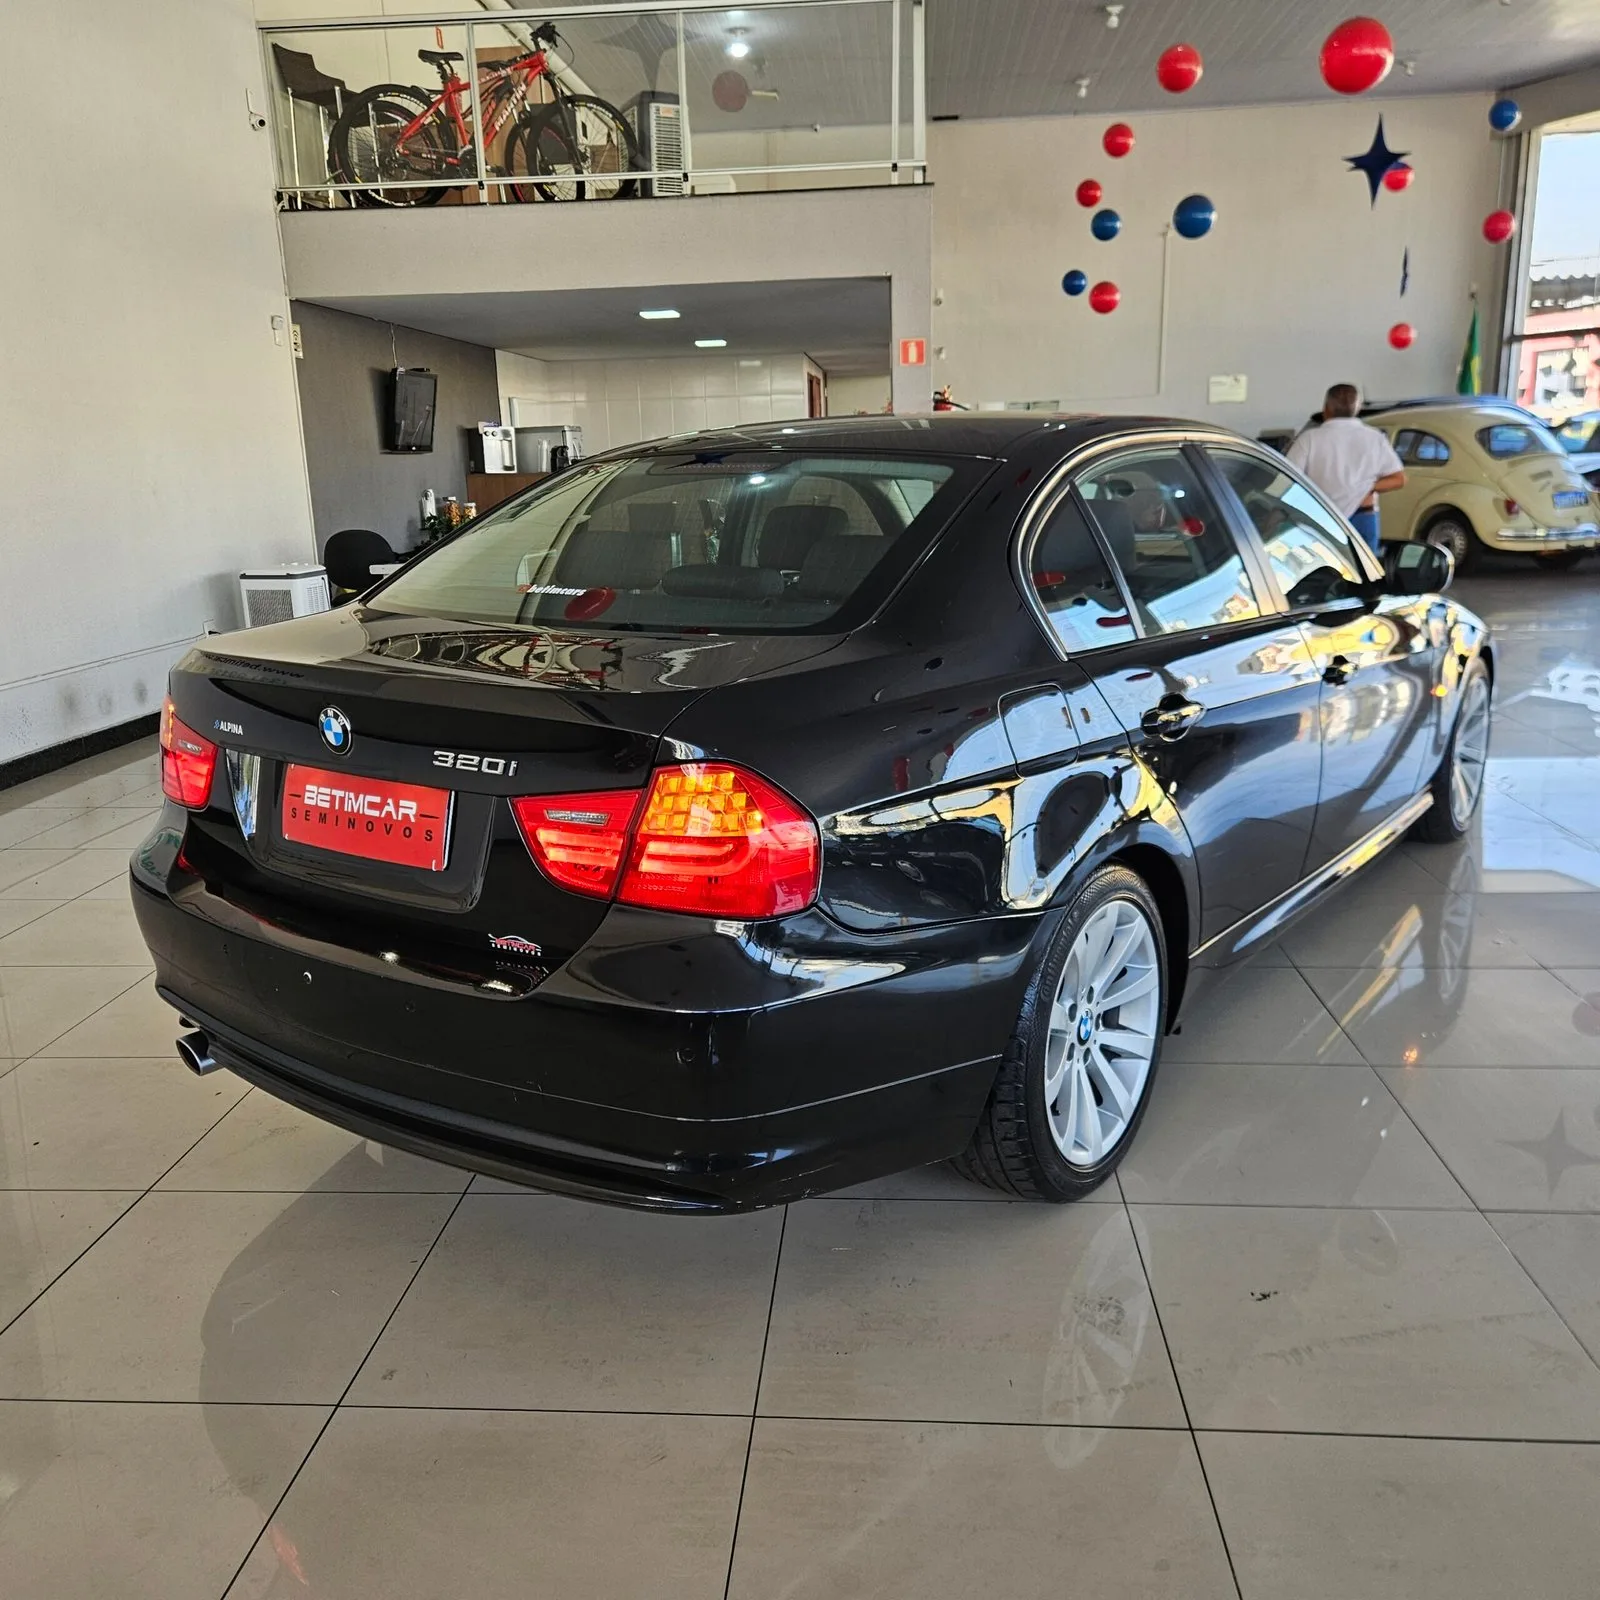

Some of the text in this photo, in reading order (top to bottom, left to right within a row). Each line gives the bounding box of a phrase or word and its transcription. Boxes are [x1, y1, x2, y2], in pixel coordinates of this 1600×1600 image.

[219, 720, 244, 736] ALPINA
[432, 750, 519, 777] 320i
[303, 784, 418, 823] BETIMCAR
[291, 807, 434, 842] SEMINOVOS
